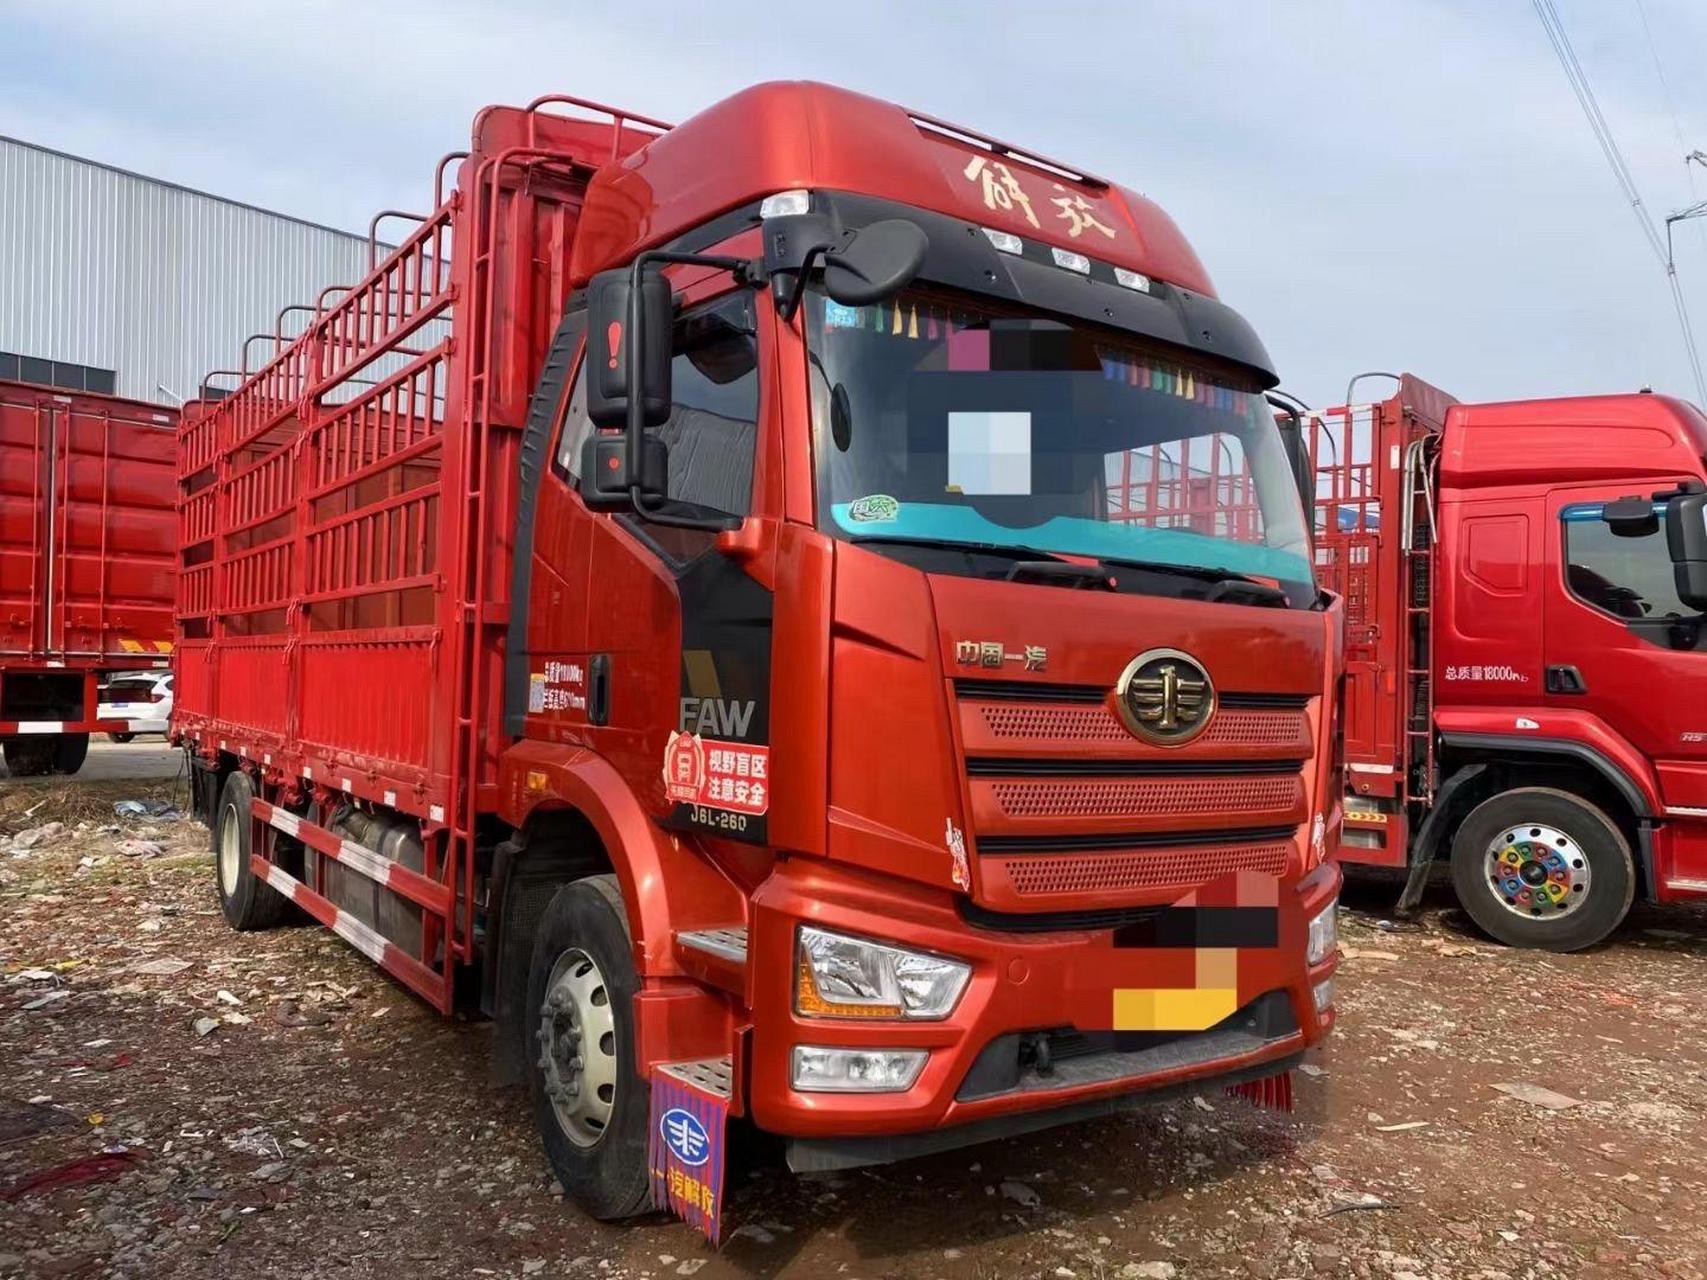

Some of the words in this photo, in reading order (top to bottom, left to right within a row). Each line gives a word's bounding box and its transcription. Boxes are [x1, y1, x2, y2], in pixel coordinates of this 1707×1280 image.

[956, 640, 1047, 671] 中国一汽
[679, 697, 755, 738] FAW
[709, 749, 768, 779] 视野盲区
[708, 777, 766, 806] 注意安全
